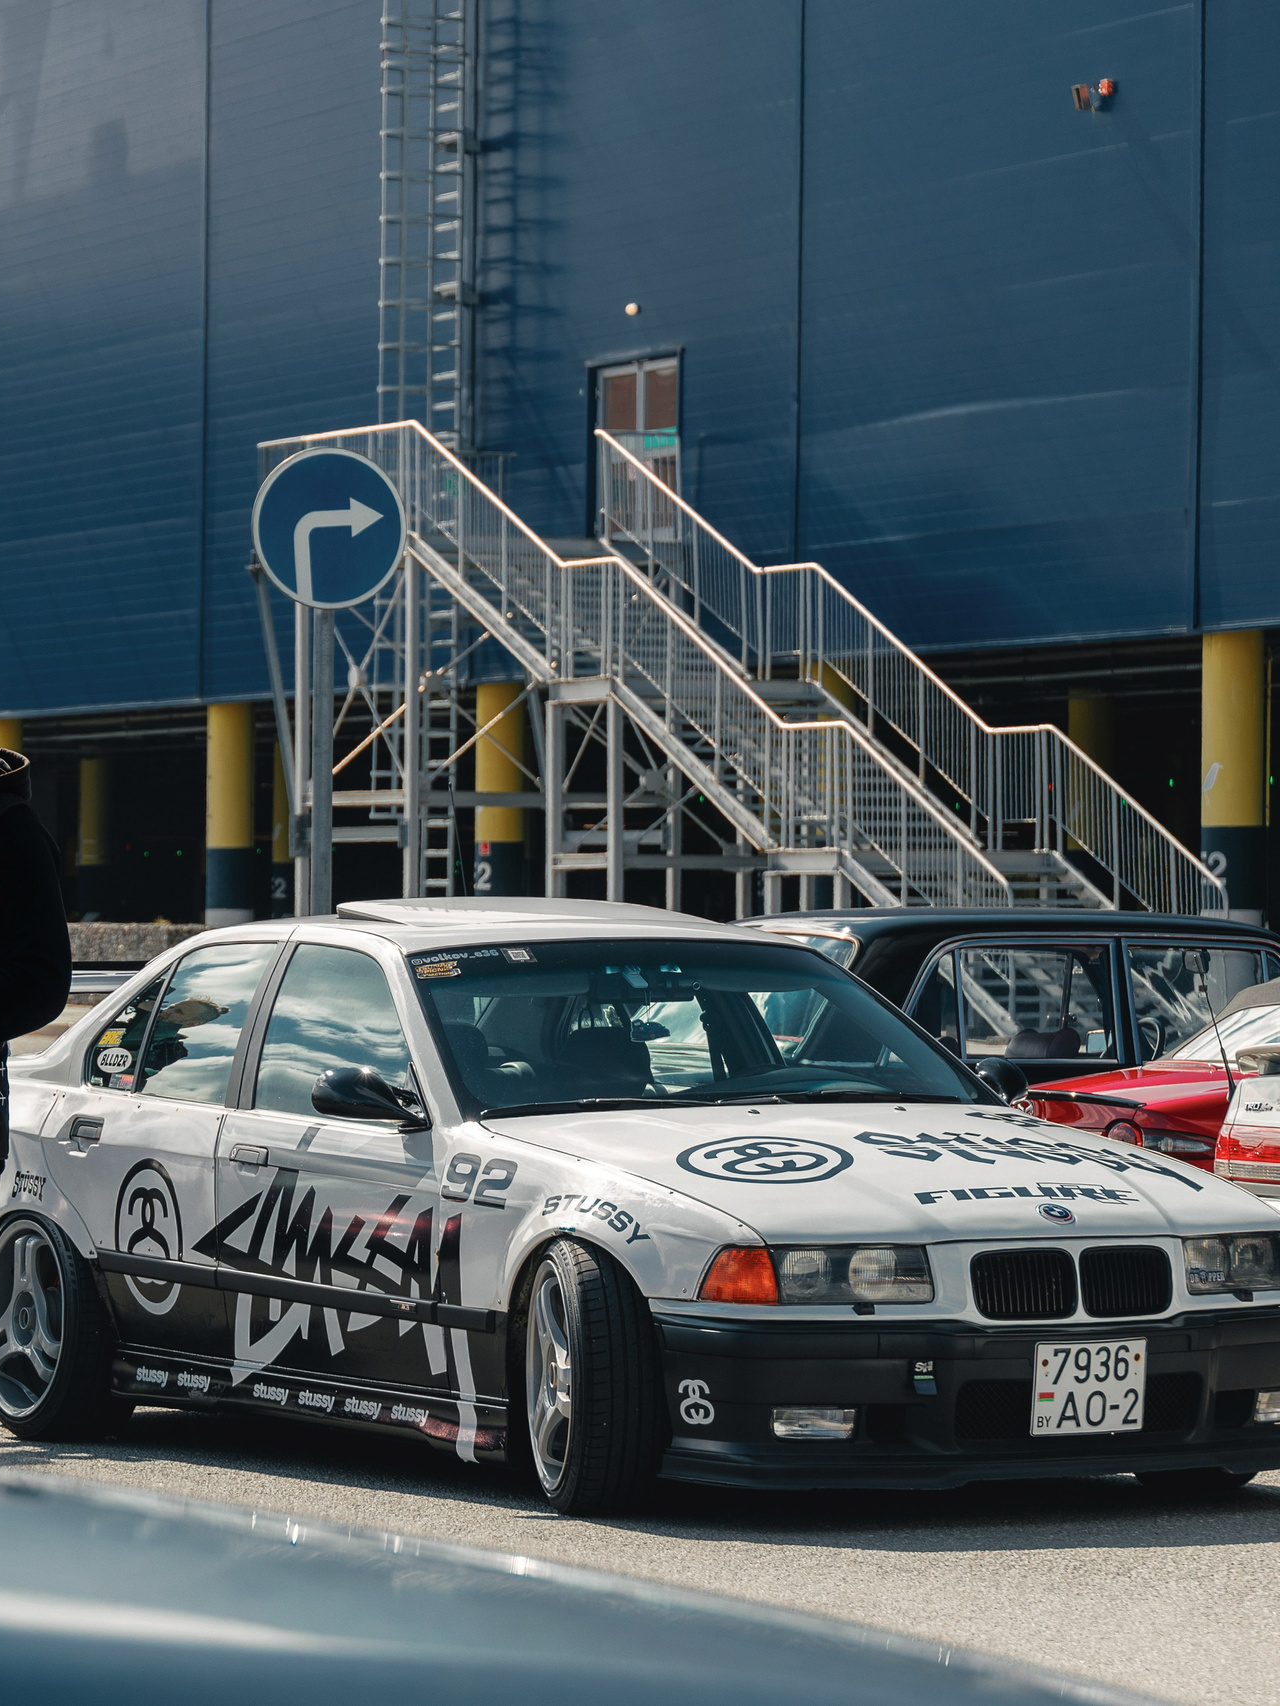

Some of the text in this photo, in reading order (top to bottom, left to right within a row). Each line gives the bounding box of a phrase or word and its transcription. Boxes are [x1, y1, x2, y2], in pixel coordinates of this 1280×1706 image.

[100, 1053, 129, 1068] BLLDZR
[441, 1153, 518, 1210] 92
[542, 1194, 651, 1245] STUSSY
[1052, 1345, 1130, 1385] 7936
[137, 1367, 429, 1429] stussy stussy stussy stussy stussy stussy
[1056, 1388, 1139, 1429] AO-2
[1037, 1416, 1051, 1428] BY
